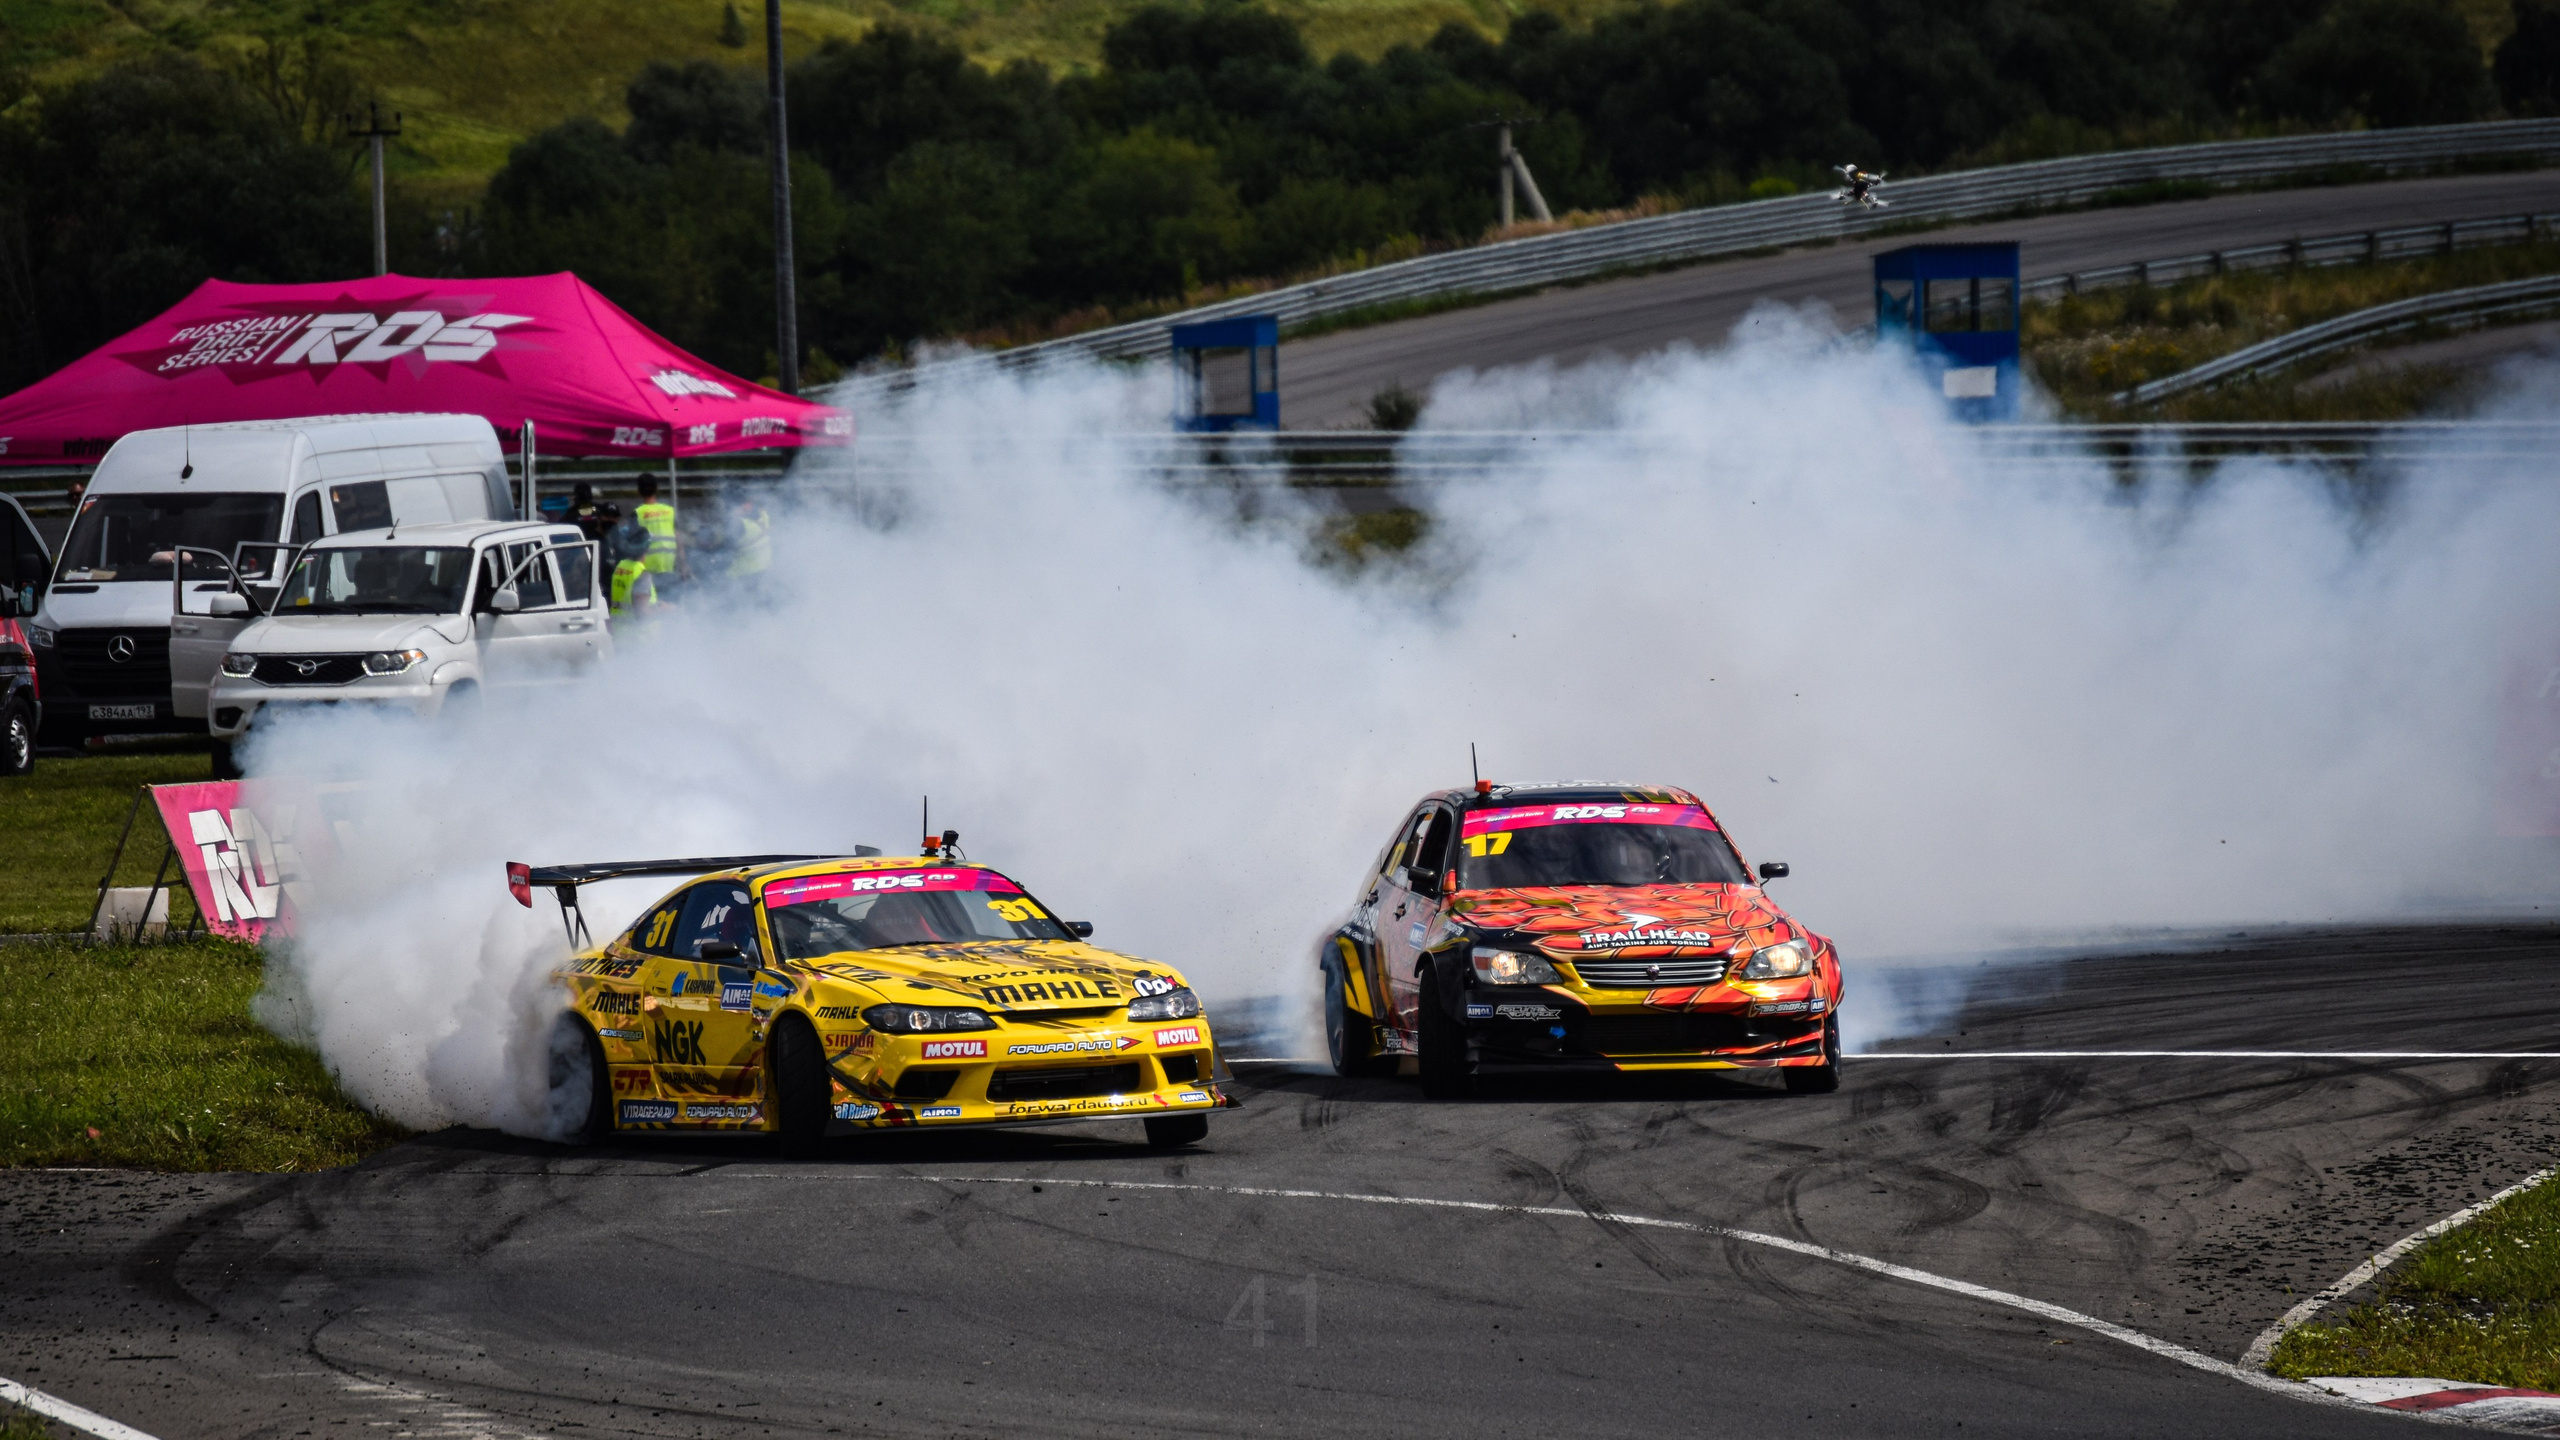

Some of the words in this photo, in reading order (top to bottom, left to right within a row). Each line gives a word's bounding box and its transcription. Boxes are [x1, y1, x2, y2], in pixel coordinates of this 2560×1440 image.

[169, 316, 298, 342] RUSSIAN
[273, 311, 535, 363] RDS
[190, 331, 280, 352] DRIFT
[158, 346, 260, 371] SERIES
[611, 427, 664, 445] RDS
[1552, 805, 1630, 821] RDS
[1631, 807, 1661, 815] GP
[1462, 832, 1512, 858] 17
[783, 886, 807, 895] Russian
[852, 874, 925, 891] RDS
[927, 873, 958, 882] GP
[987, 897, 1048, 922] 31
[645, 910, 678, 949] 31
[1581, 930, 1712, 943] TRAILHEAD
[1588, 941, 1609, 949] AIN'T
[593, 958, 645, 979] TIRES
[956, 970, 1028, 983] TOYO
[1030, 967, 1112, 976] TIRES
[980, 980, 1121, 1005] MAHLE
[592, 992, 641, 1015] MAHLE
[815, 1006, 860, 1019] MAHLE
[1468, 1007, 1491, 1016] AIMOL
[655, 1020, 706, 1066] NGK
[1008, 1042, 1076, 1054] FORWARD
[1077, 1040, 1112, 1051] AUTO
[1157, 1029, 1198, 1046] MOTUL
[925, 1042, 984, 1058] MOTUL
[614, 1070, 651, 1091] CTR
[623, 1105, 675, 1118] VIRAGE24.RU
[922, 1108, 960, 1117] AIMOL
[1009, 1096, 1148, 1114] forwardauto.ru
